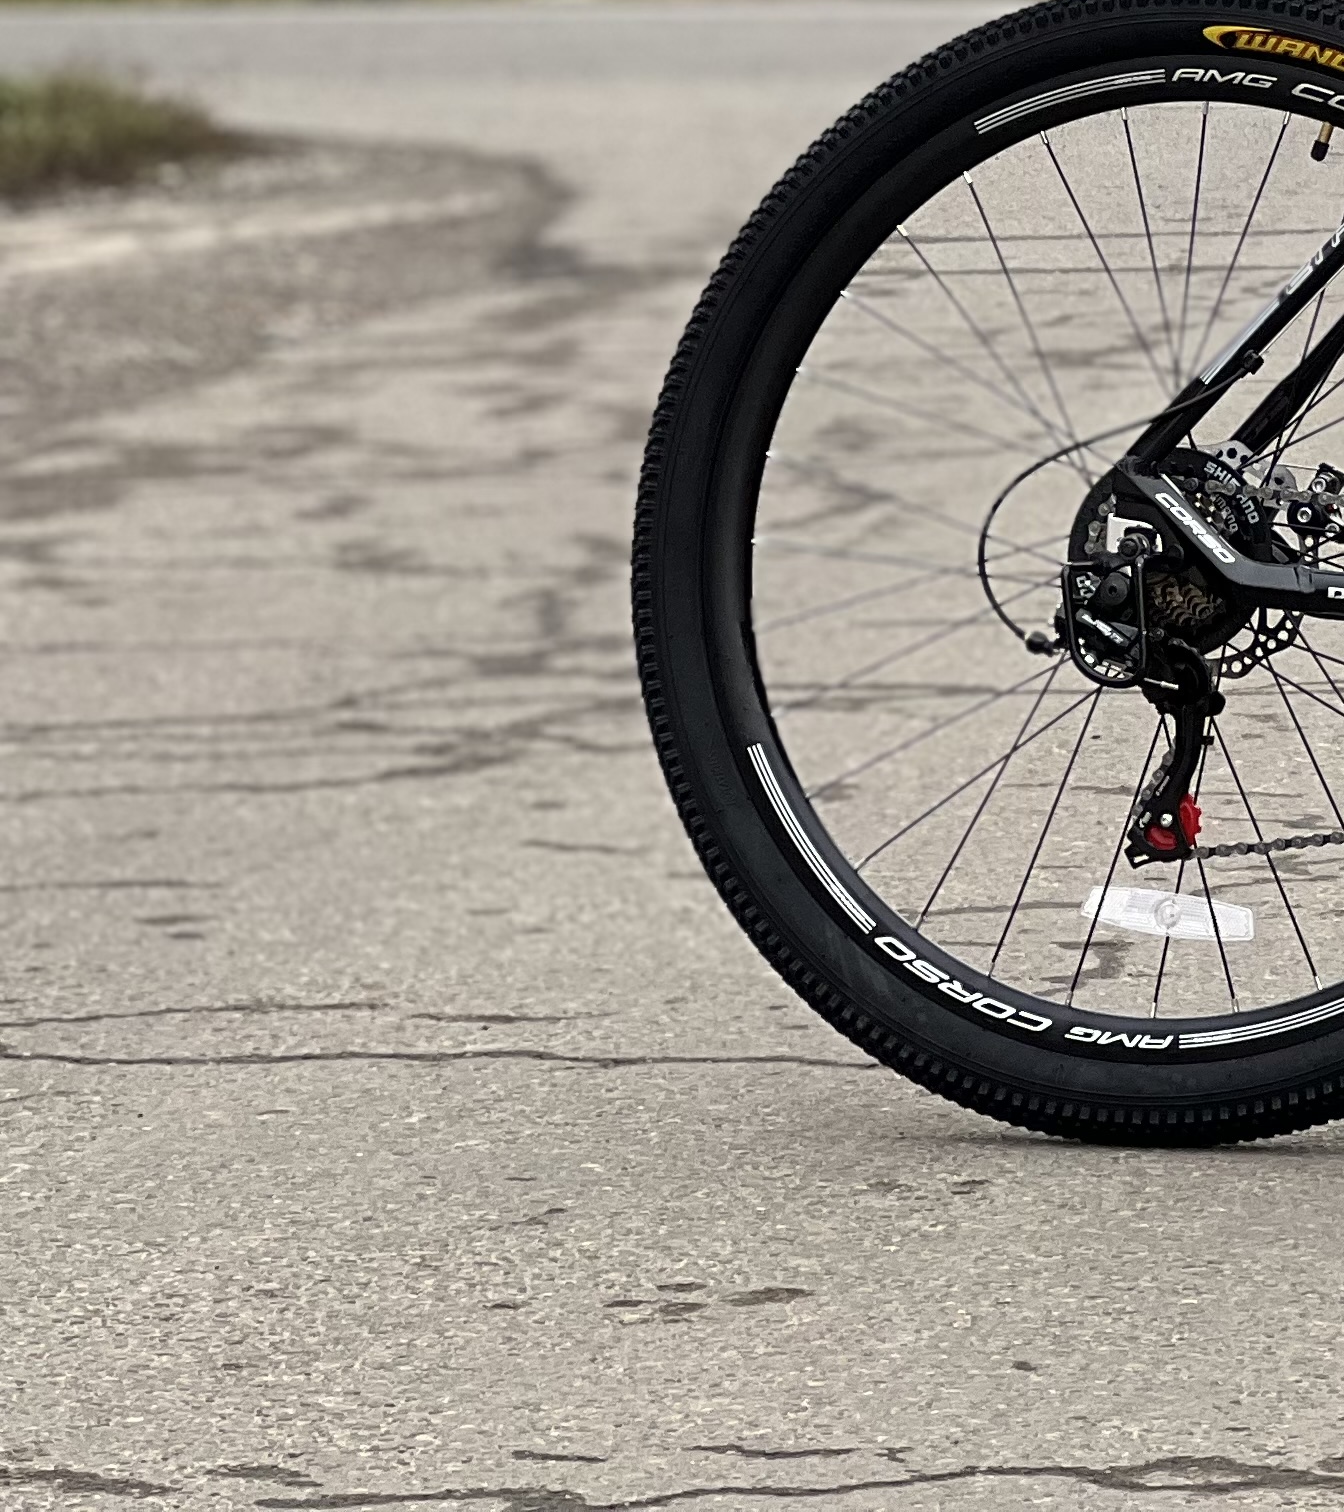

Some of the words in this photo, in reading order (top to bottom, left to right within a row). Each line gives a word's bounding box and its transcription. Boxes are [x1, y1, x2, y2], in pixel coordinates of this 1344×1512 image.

[1171, 68, 1278, 89] AMG
[1154, 492, 1236, 564] CORSO
[874, 936, 1053, 1033] CORSO
[1064, 1025, 1174, 1050] AMG
